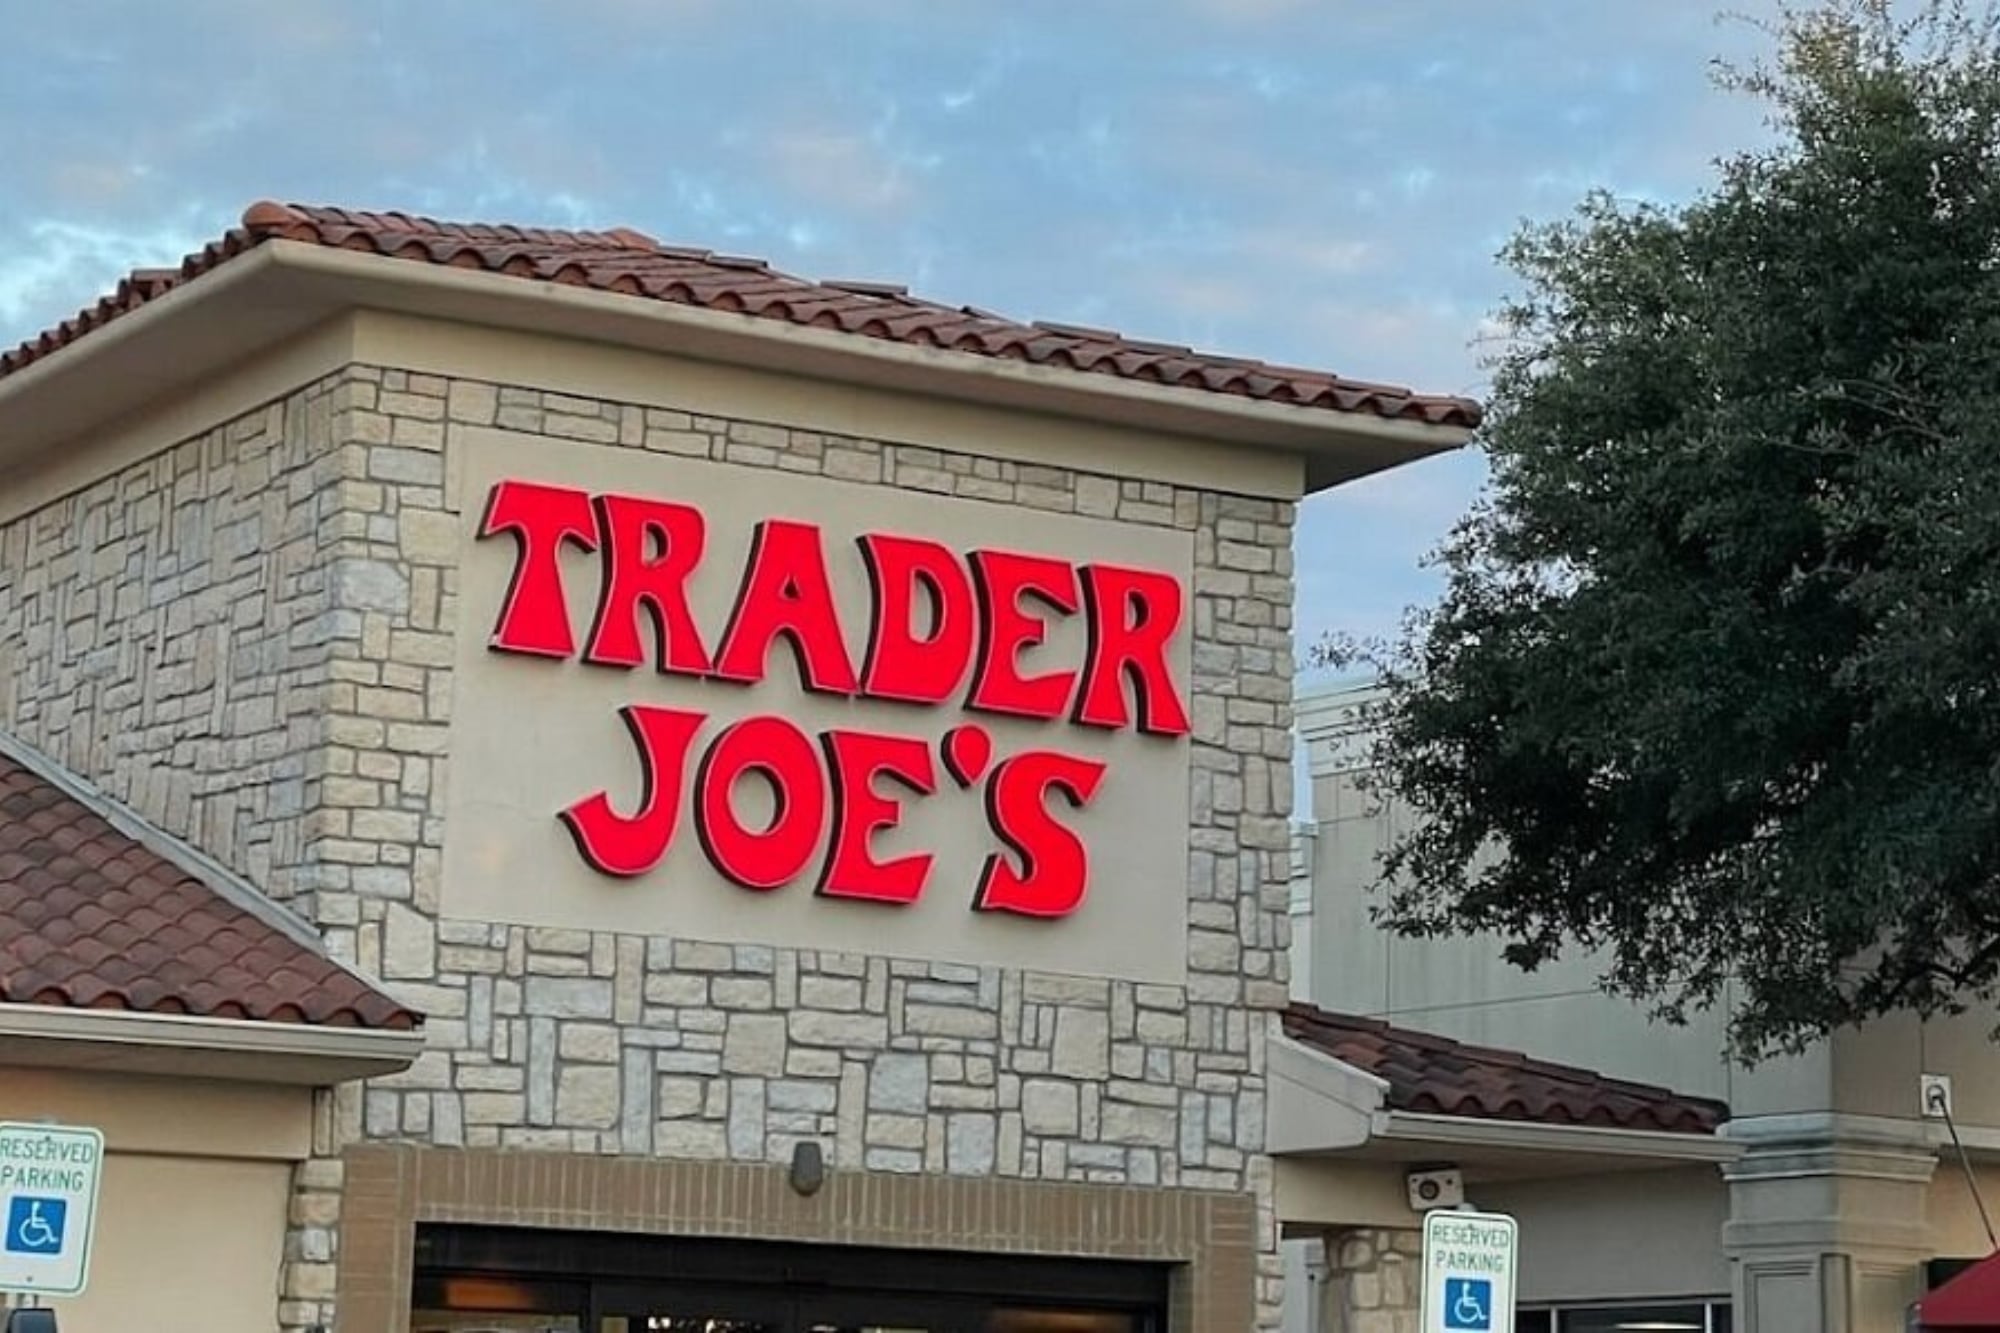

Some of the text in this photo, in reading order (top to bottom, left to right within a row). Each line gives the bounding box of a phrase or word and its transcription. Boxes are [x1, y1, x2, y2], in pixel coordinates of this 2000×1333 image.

[476, 480, 1191, 736] TRADER
[557, 705, 1107, 919] JOE'S
[0, 1137, 93, 1164] RESERVED
[1, 1165, 84, 1192] PARKING
[1432, 1225, 1509, 1247] RESERVED
[1436, 1250, 1505, 1272] PARKING
